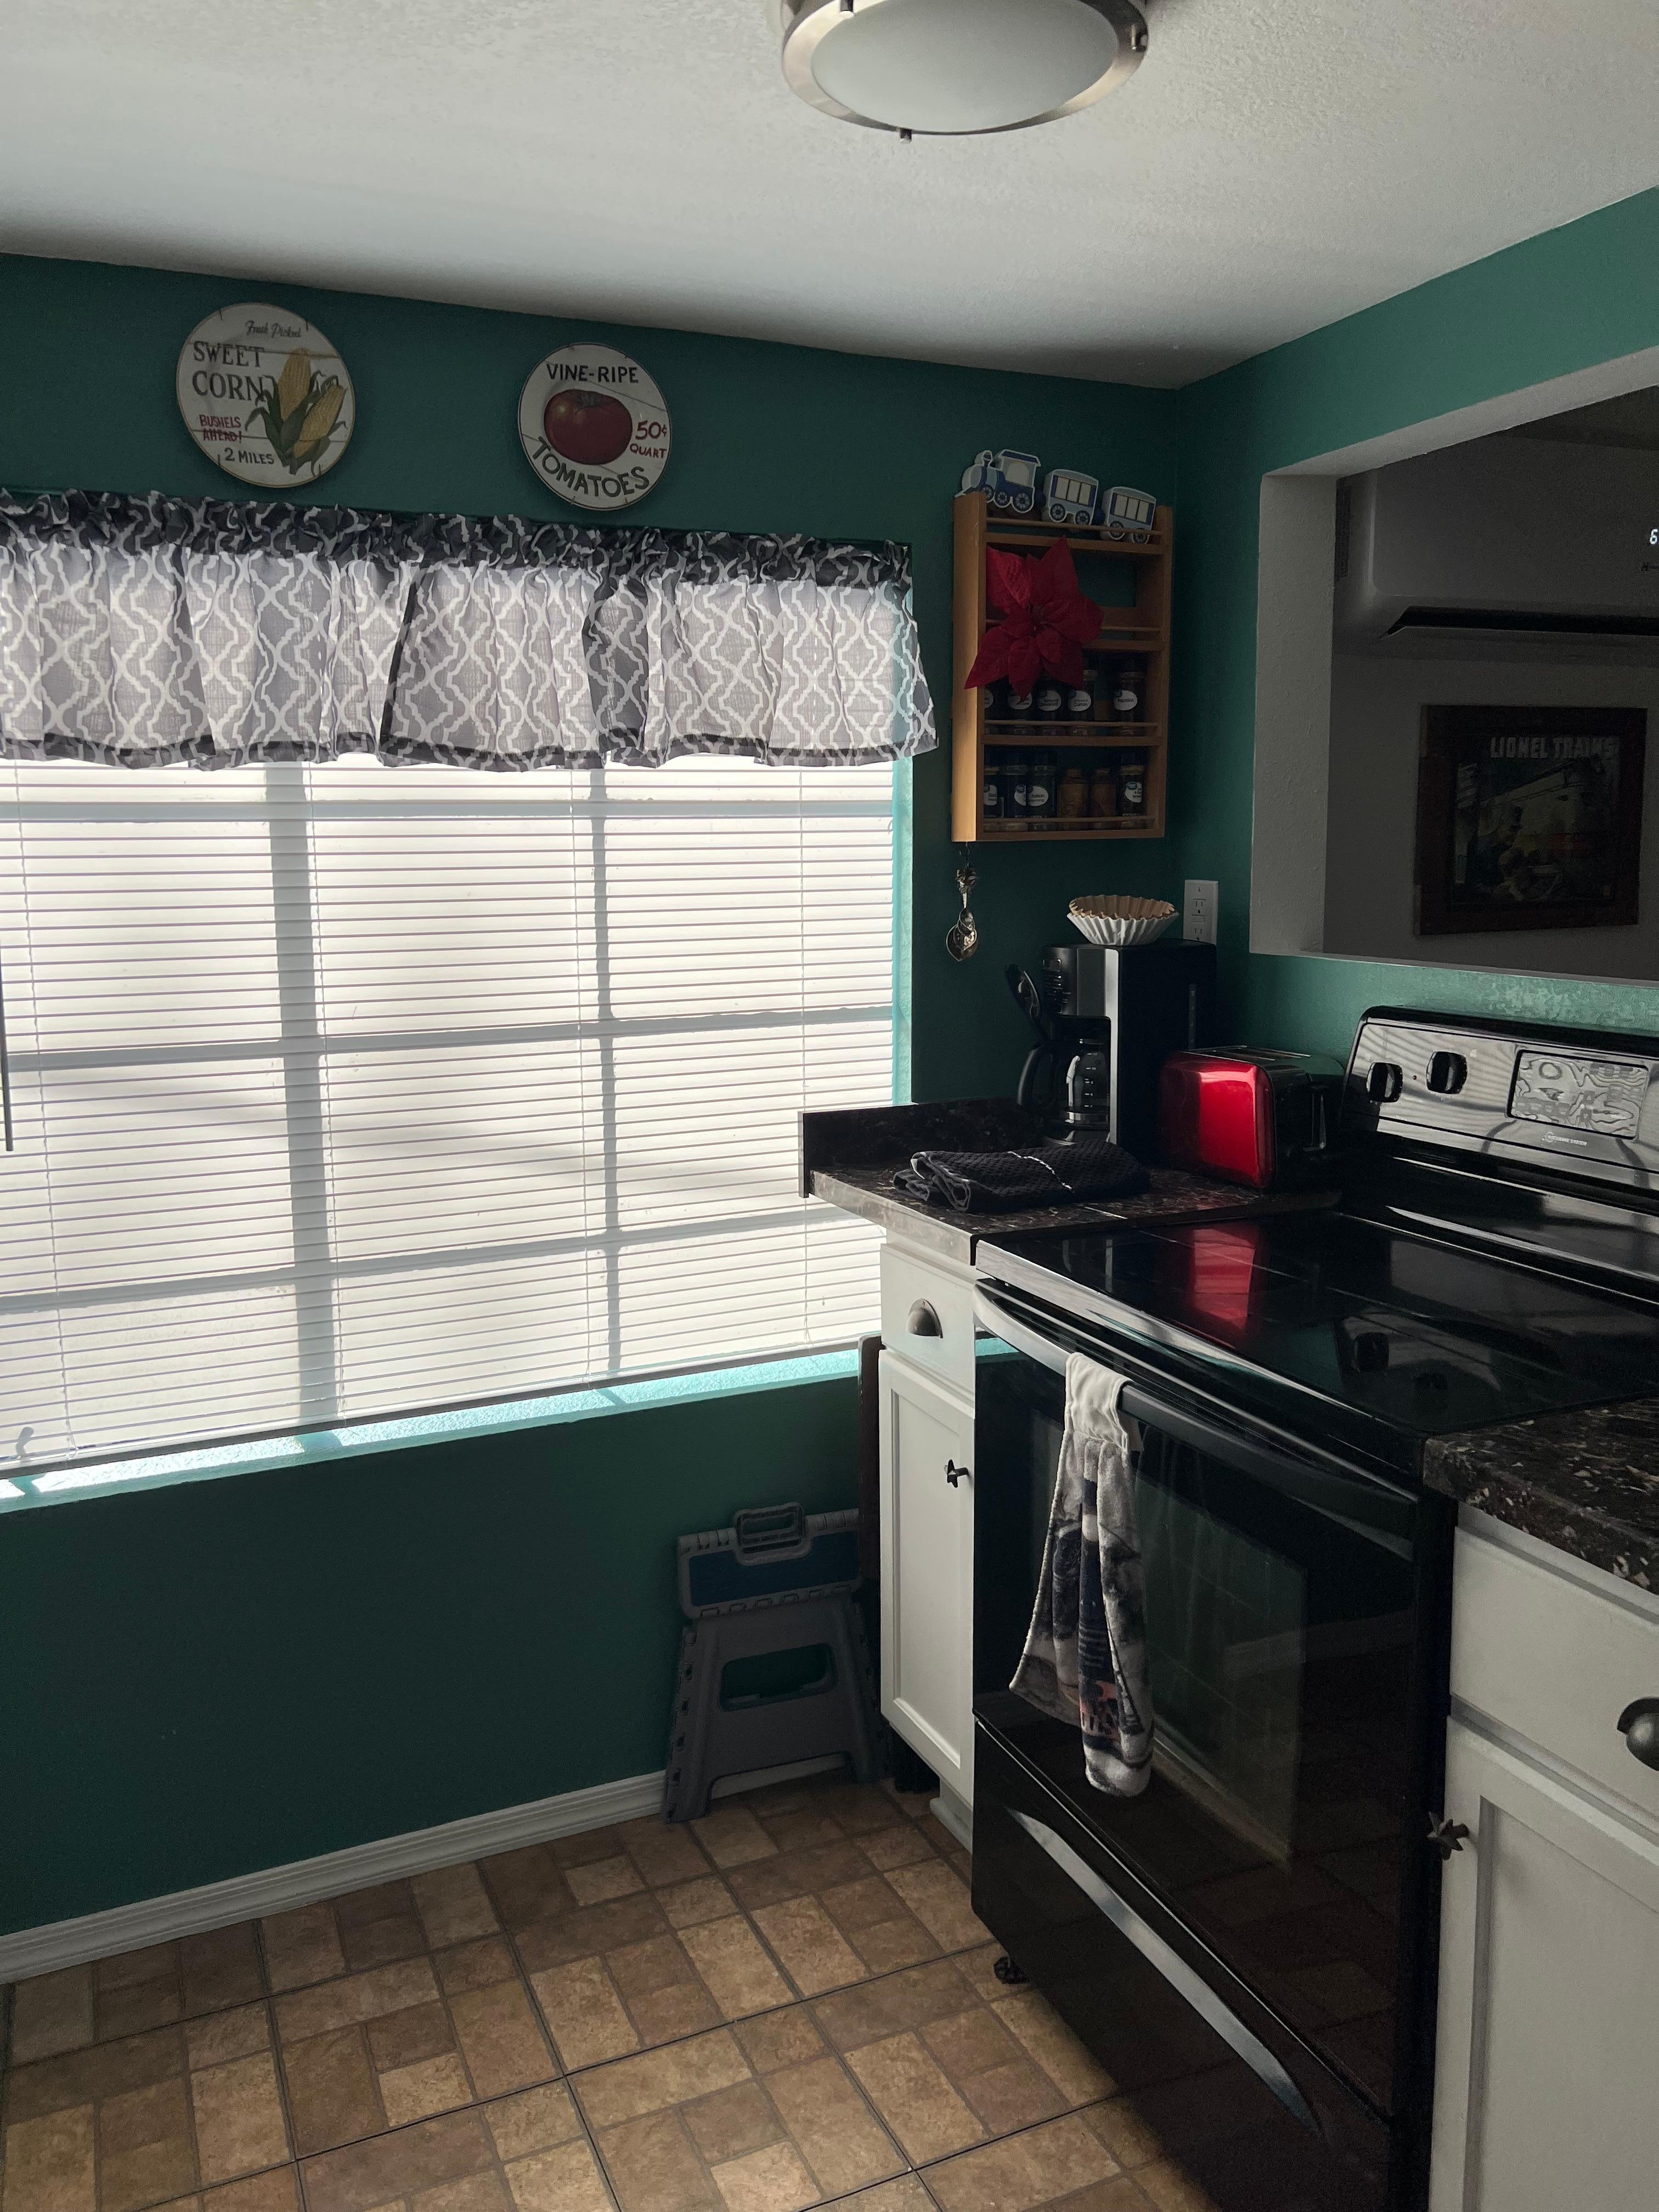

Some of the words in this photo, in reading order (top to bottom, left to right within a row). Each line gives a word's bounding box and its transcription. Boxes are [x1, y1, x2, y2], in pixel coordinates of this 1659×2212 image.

[271, 323, 301, 338] Picked
[193, 340, 265, 368] SWEET
[546, 363, 639, 383] VINE-RIPE
[192, 370, 267, 402] CORN
[199, 414, 241, 428] BUSHELS
[224, 447, 235, 462] 2
[238, 450, 275, 465] MILES
[629, 443, 667, 459] QUART
[532, 436, 650, 497] TOMATOES
[1491, 737, 1548, 759] LIONEL
[1553, 737, 1620, 759] TRAINS
